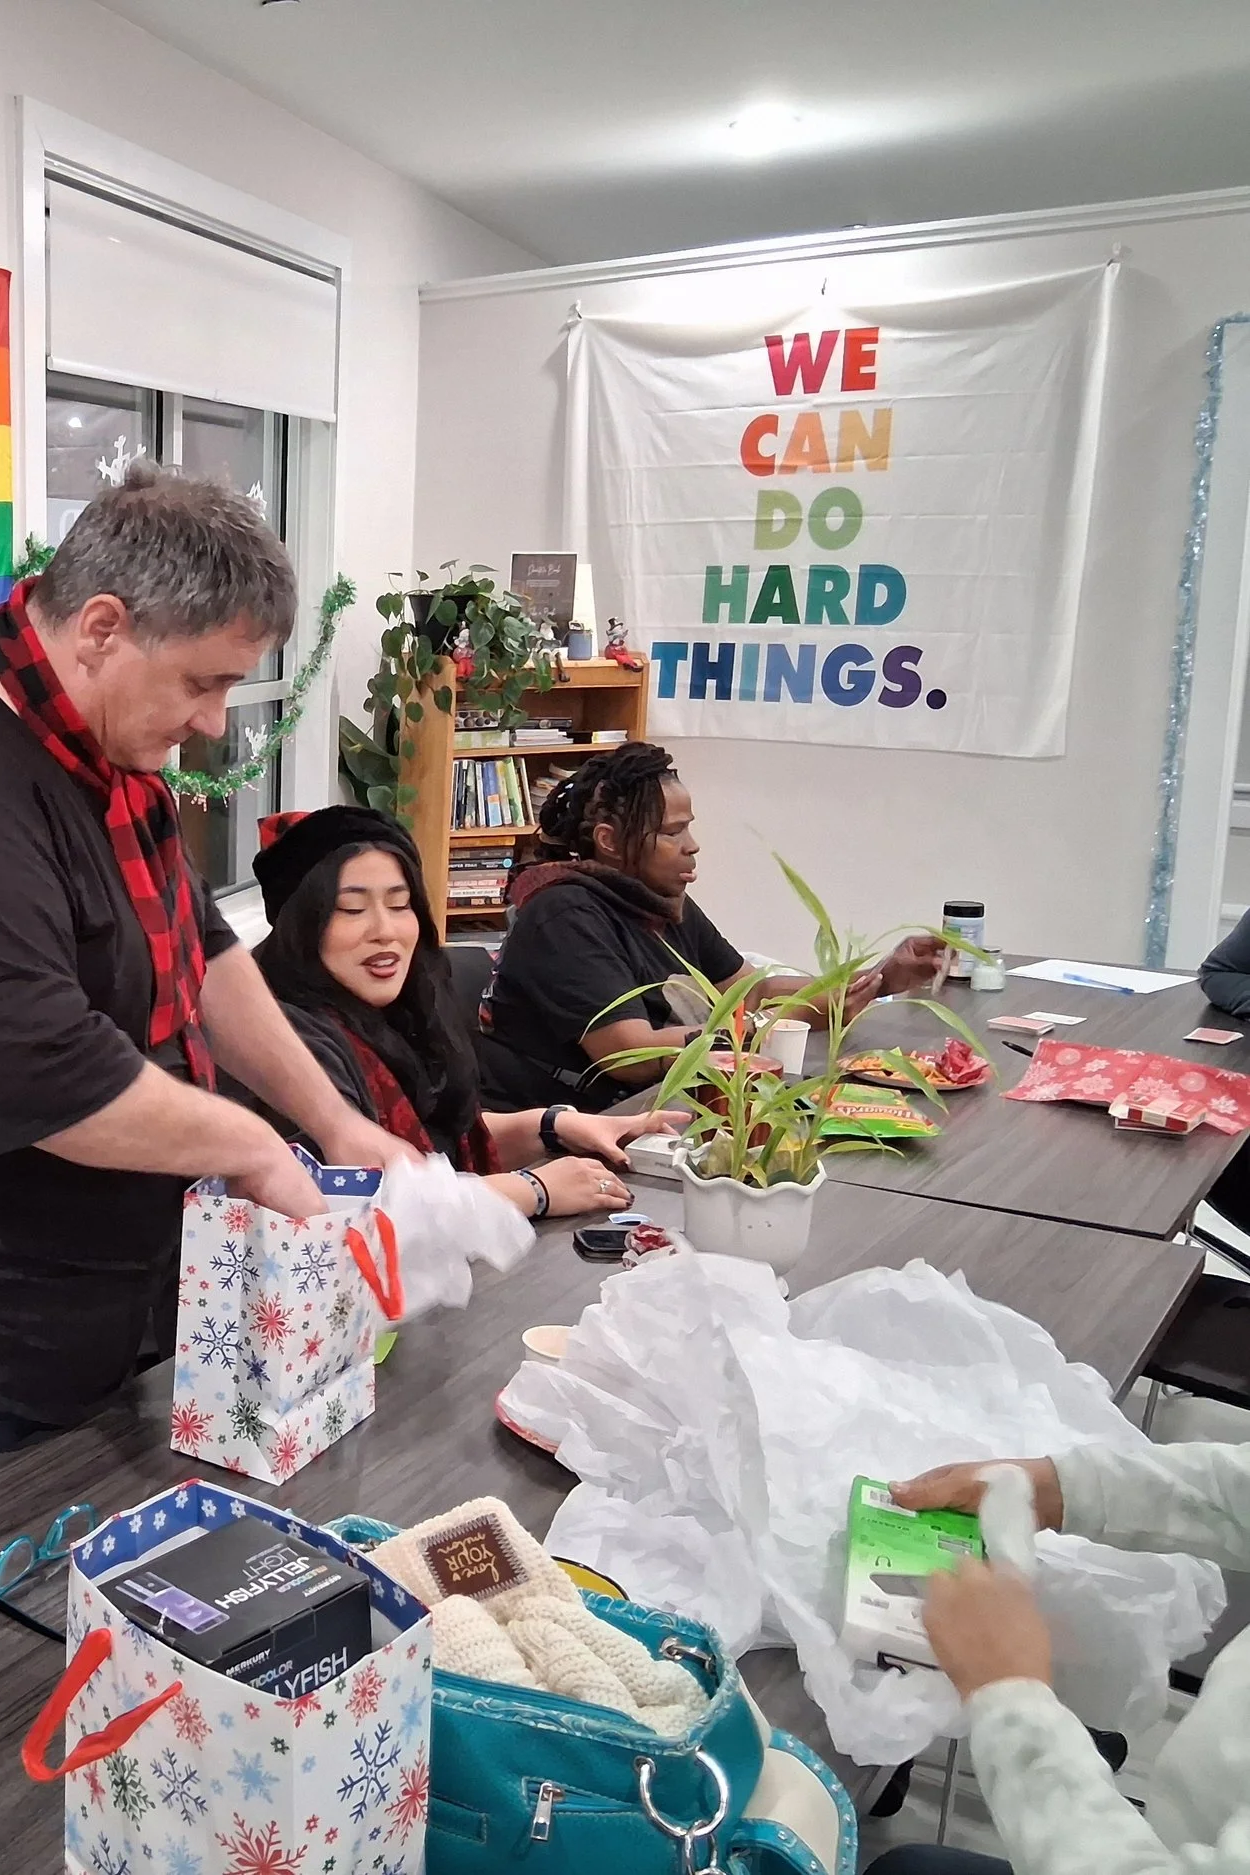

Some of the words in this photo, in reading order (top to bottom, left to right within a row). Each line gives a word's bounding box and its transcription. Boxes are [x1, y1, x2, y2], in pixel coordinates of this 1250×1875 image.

[764, 327, 880, 396] WE
[740, 408, 892, 477] CAN
[754, 487, 863, 551] DO
[702, 565, 907, 626] HARD
[651, 642, 947, 710] THINGS.
[242, 1546, 299, 1582] LIGHT
[436, 1532, 486, 1555] melon
[444, 1543, 494, 1572] YOUR
[214, 1556, 310, 1610] JELLYFISH
[461, 1555, 500, 1583] love
[225, 1648, 271, 1677] MERKURY
[249, 1660, 293, 1688] TICOLOR
